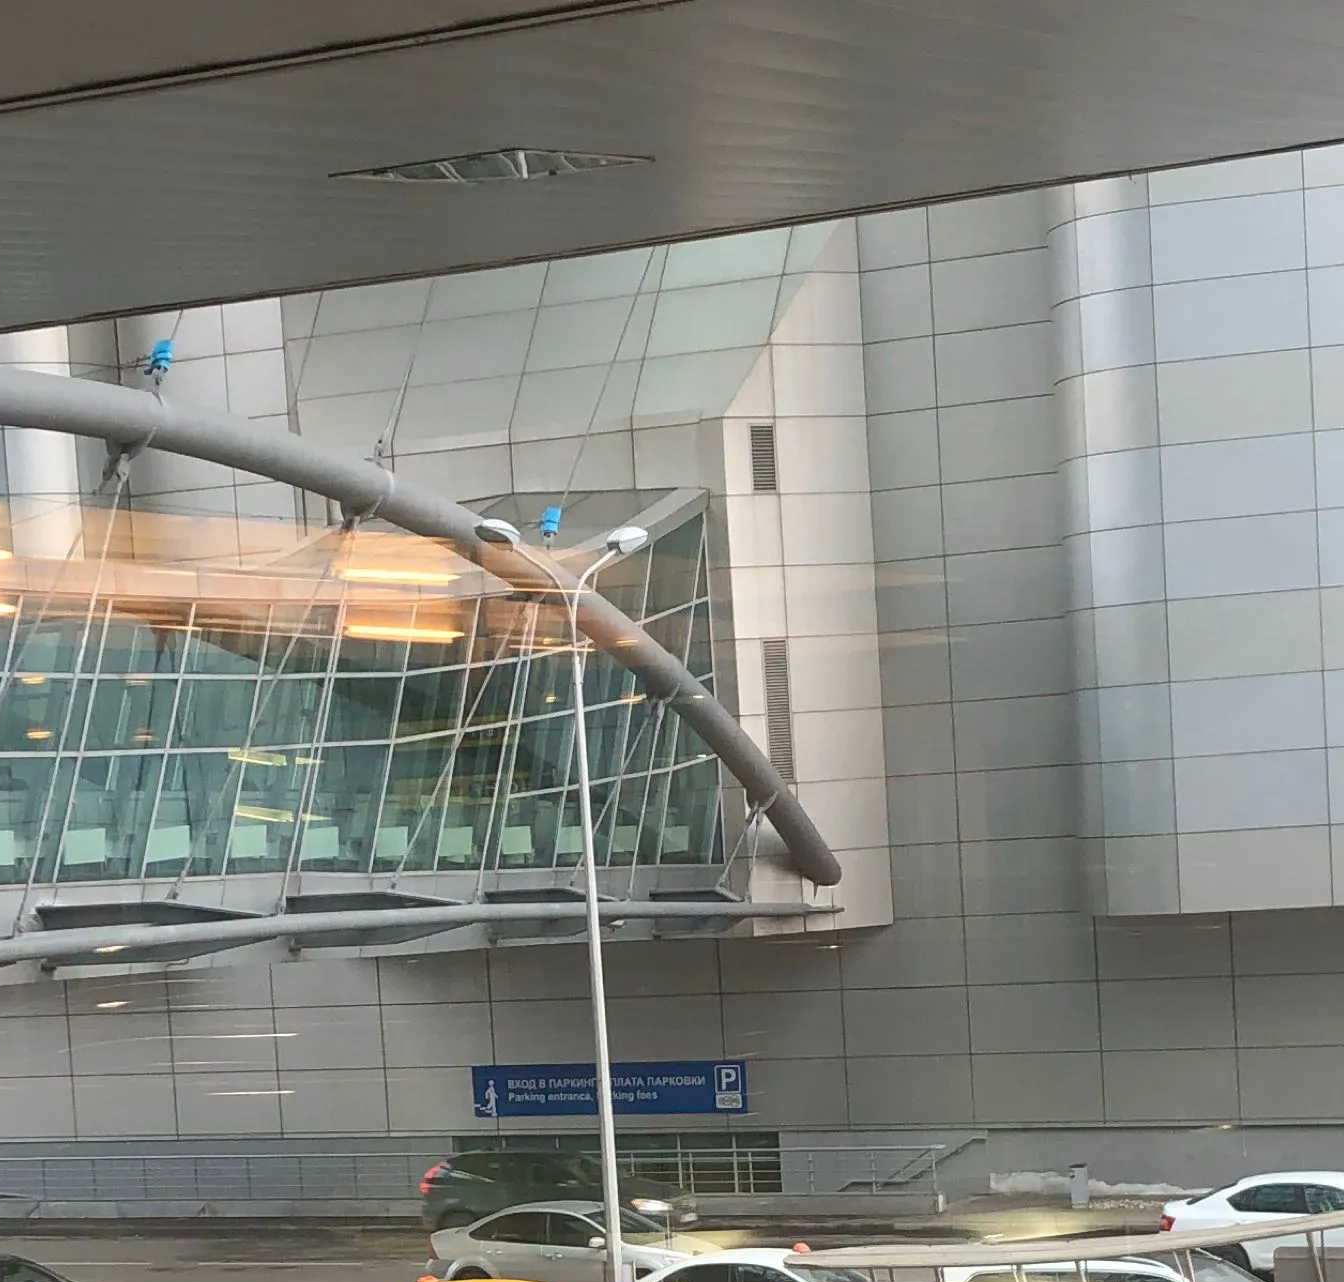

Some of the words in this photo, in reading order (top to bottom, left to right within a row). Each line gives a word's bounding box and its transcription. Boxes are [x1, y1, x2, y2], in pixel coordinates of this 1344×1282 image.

[507, 1078, 536, 1090] ВХОД
[539, 1079, 546, 1089] В
[609, 1076, 644, 1087] ПЛАТА
[647, 1075, 705, 1087] ПАРКОВКИ
[508, 1092, 545, 1103] Parking
